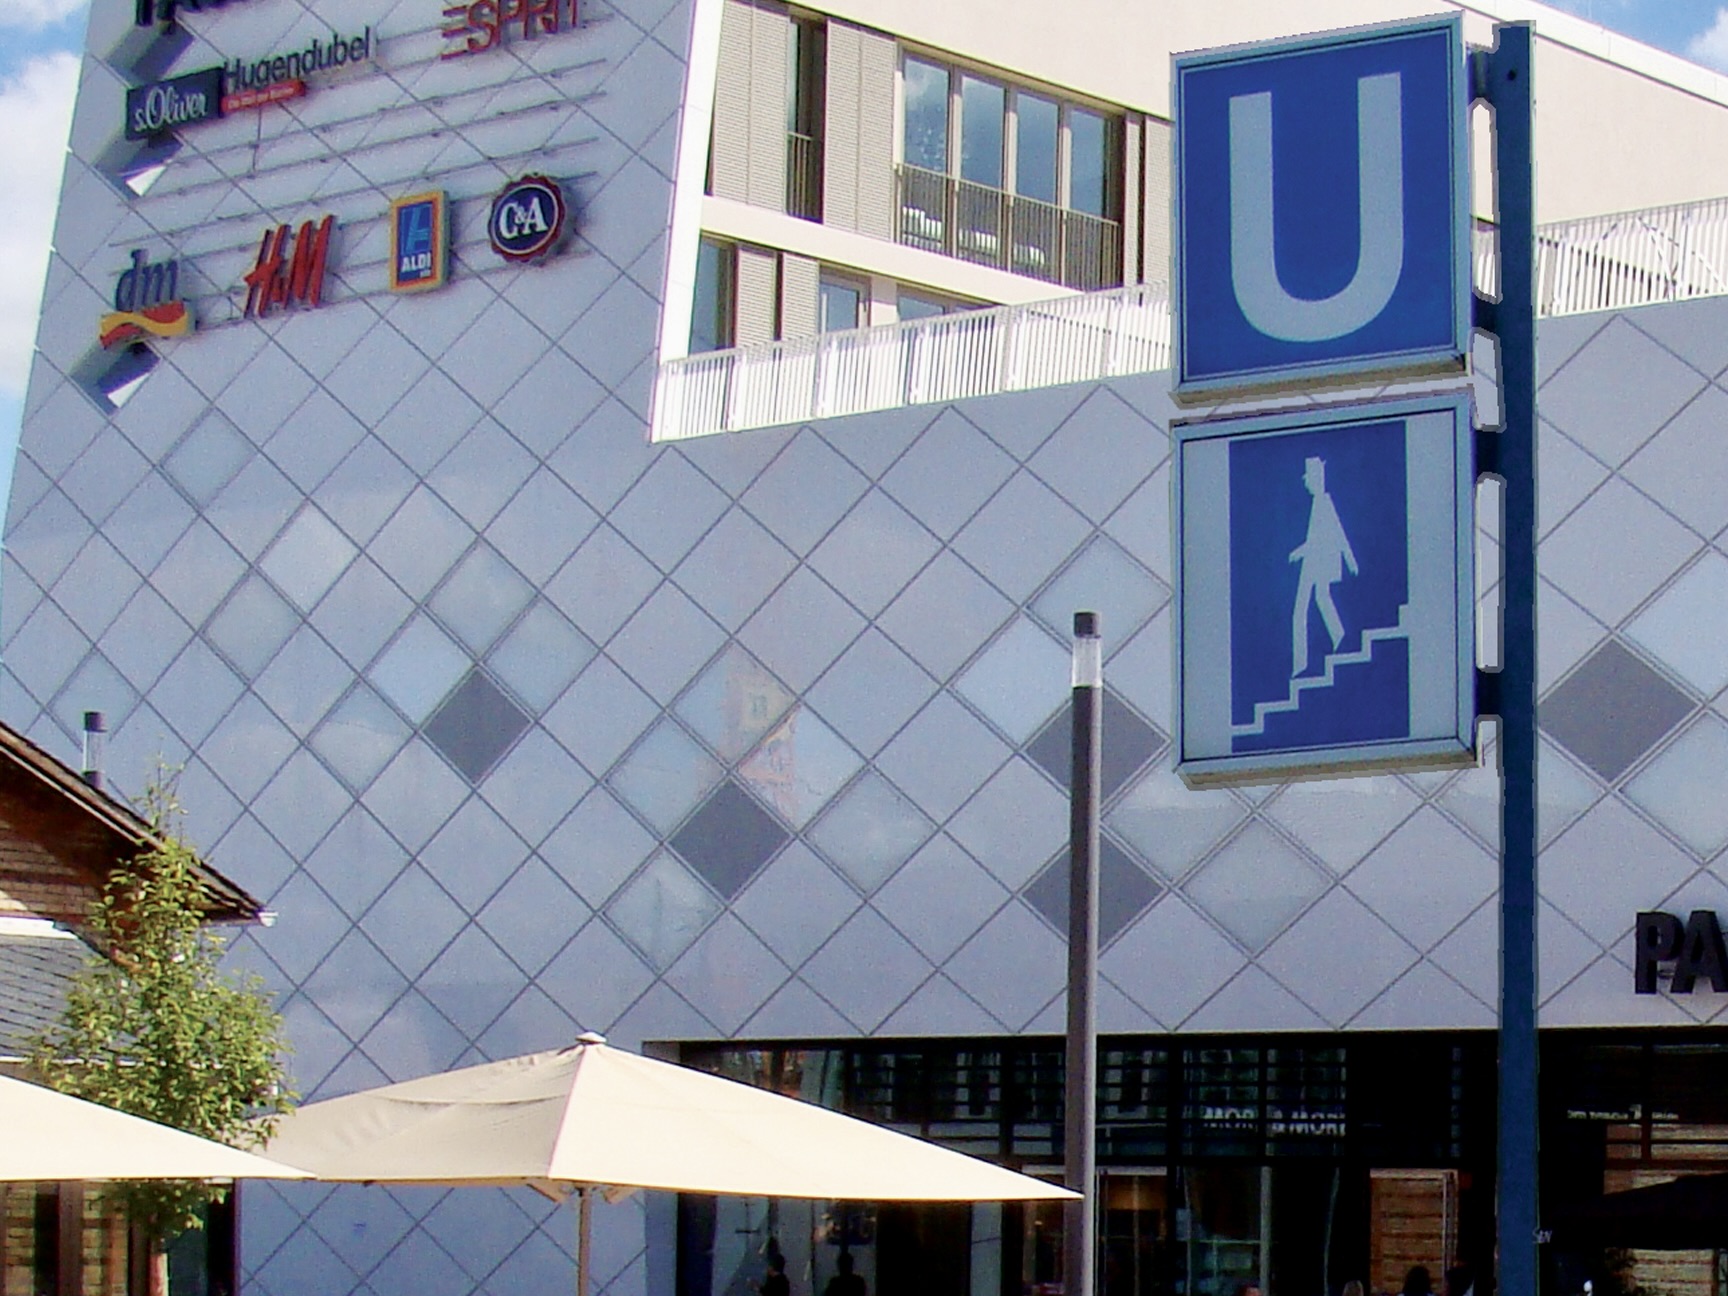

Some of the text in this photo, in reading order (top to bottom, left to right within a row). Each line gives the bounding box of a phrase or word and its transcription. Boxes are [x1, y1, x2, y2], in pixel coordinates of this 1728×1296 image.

[224, 26, 371, 94] Hugendubel
[134, 86, 207, 132] s.Oliver
[499, 196, 549, 240] C&A
[1229, 71, 1404, 342] U
[116, 249, 180, 312] dm
[402, 251, 431, 273] ALDI
